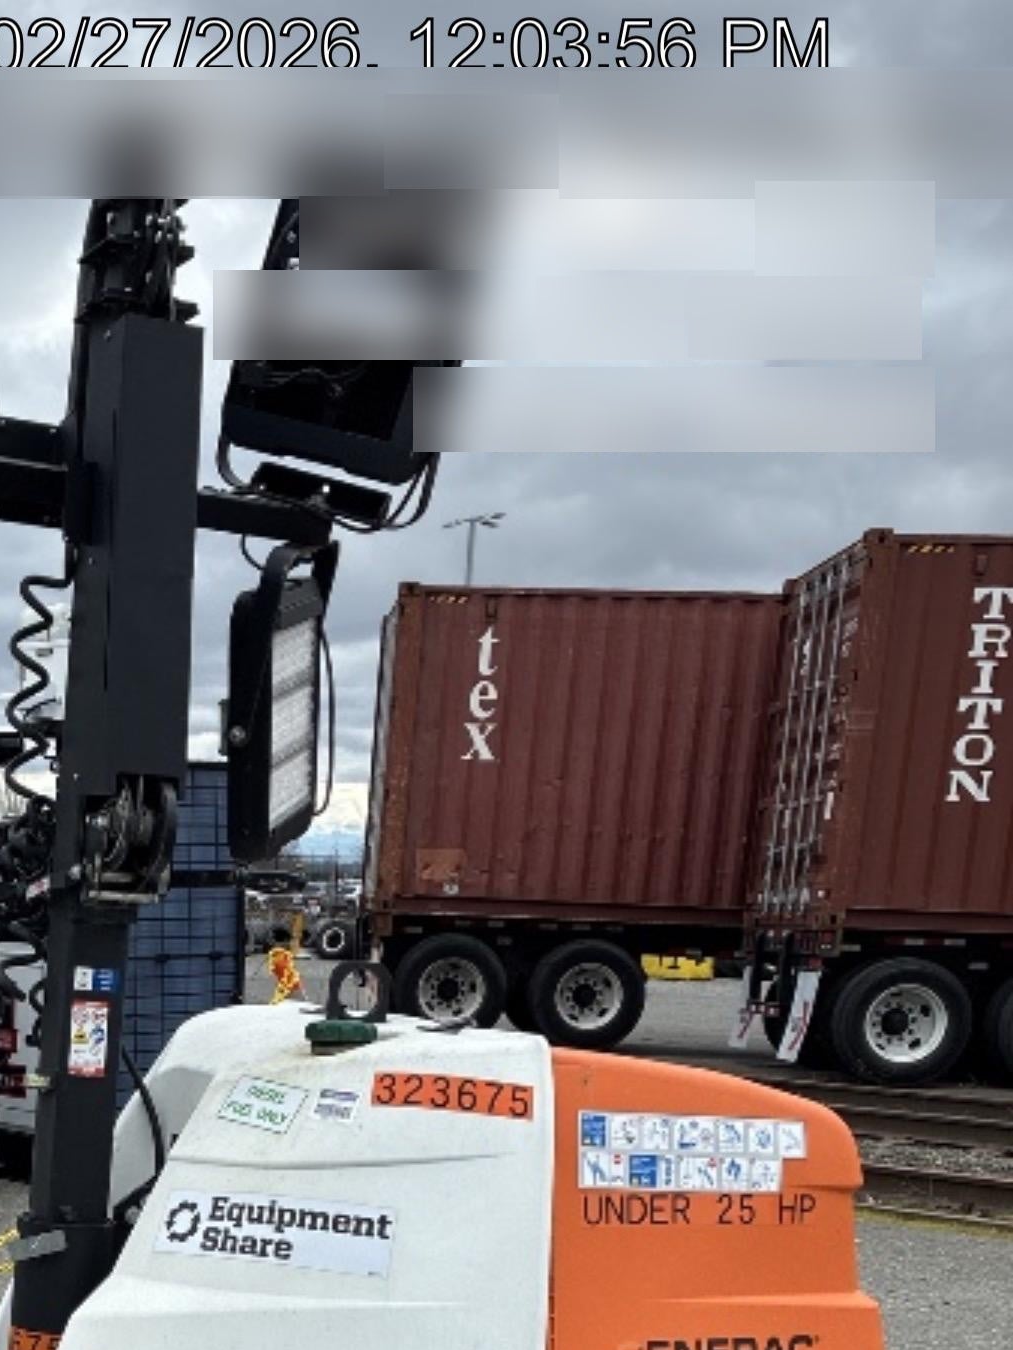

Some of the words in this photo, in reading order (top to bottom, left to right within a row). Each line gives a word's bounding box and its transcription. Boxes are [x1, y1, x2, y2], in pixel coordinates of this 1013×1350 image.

[460, 625, 500, 761] tex
[944, 586, 1013, 803] TRITON
[376, 1074, 529, 1117] 323675
[208, 1196, 393, 1240] Equipment
[583, 1194, 691, 1225] UNDER
[716, 1194, 756, 1225] 25
[778, 1194, 817, 1225] HP
[200, 1226, 294, 1260] Share
